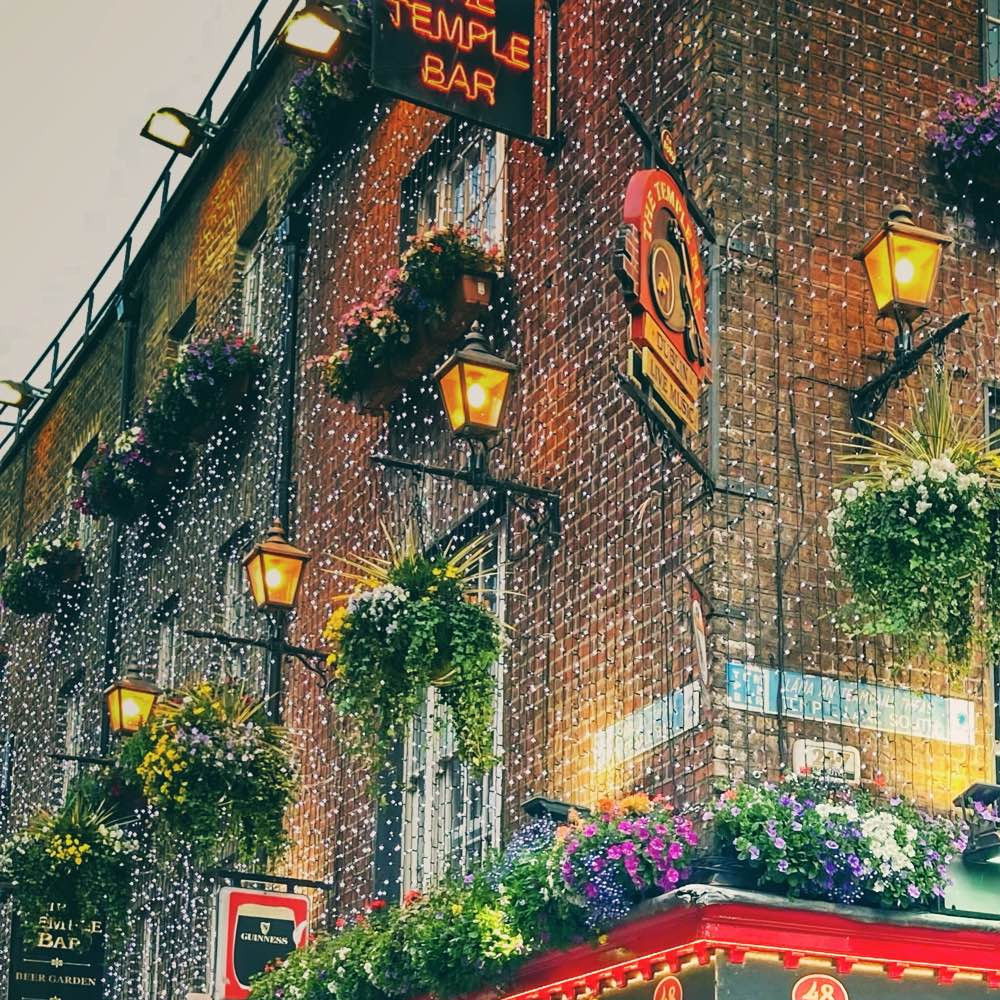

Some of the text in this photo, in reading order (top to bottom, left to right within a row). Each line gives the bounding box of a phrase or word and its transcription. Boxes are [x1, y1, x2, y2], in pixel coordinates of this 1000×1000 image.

[386, 0, 530, 69] TEMPLE
[421, 54, 496, 105] BAR
[240, 932, 288, 945] GUINNESS
[16, 971, 97, 986] BEER GARDEN
